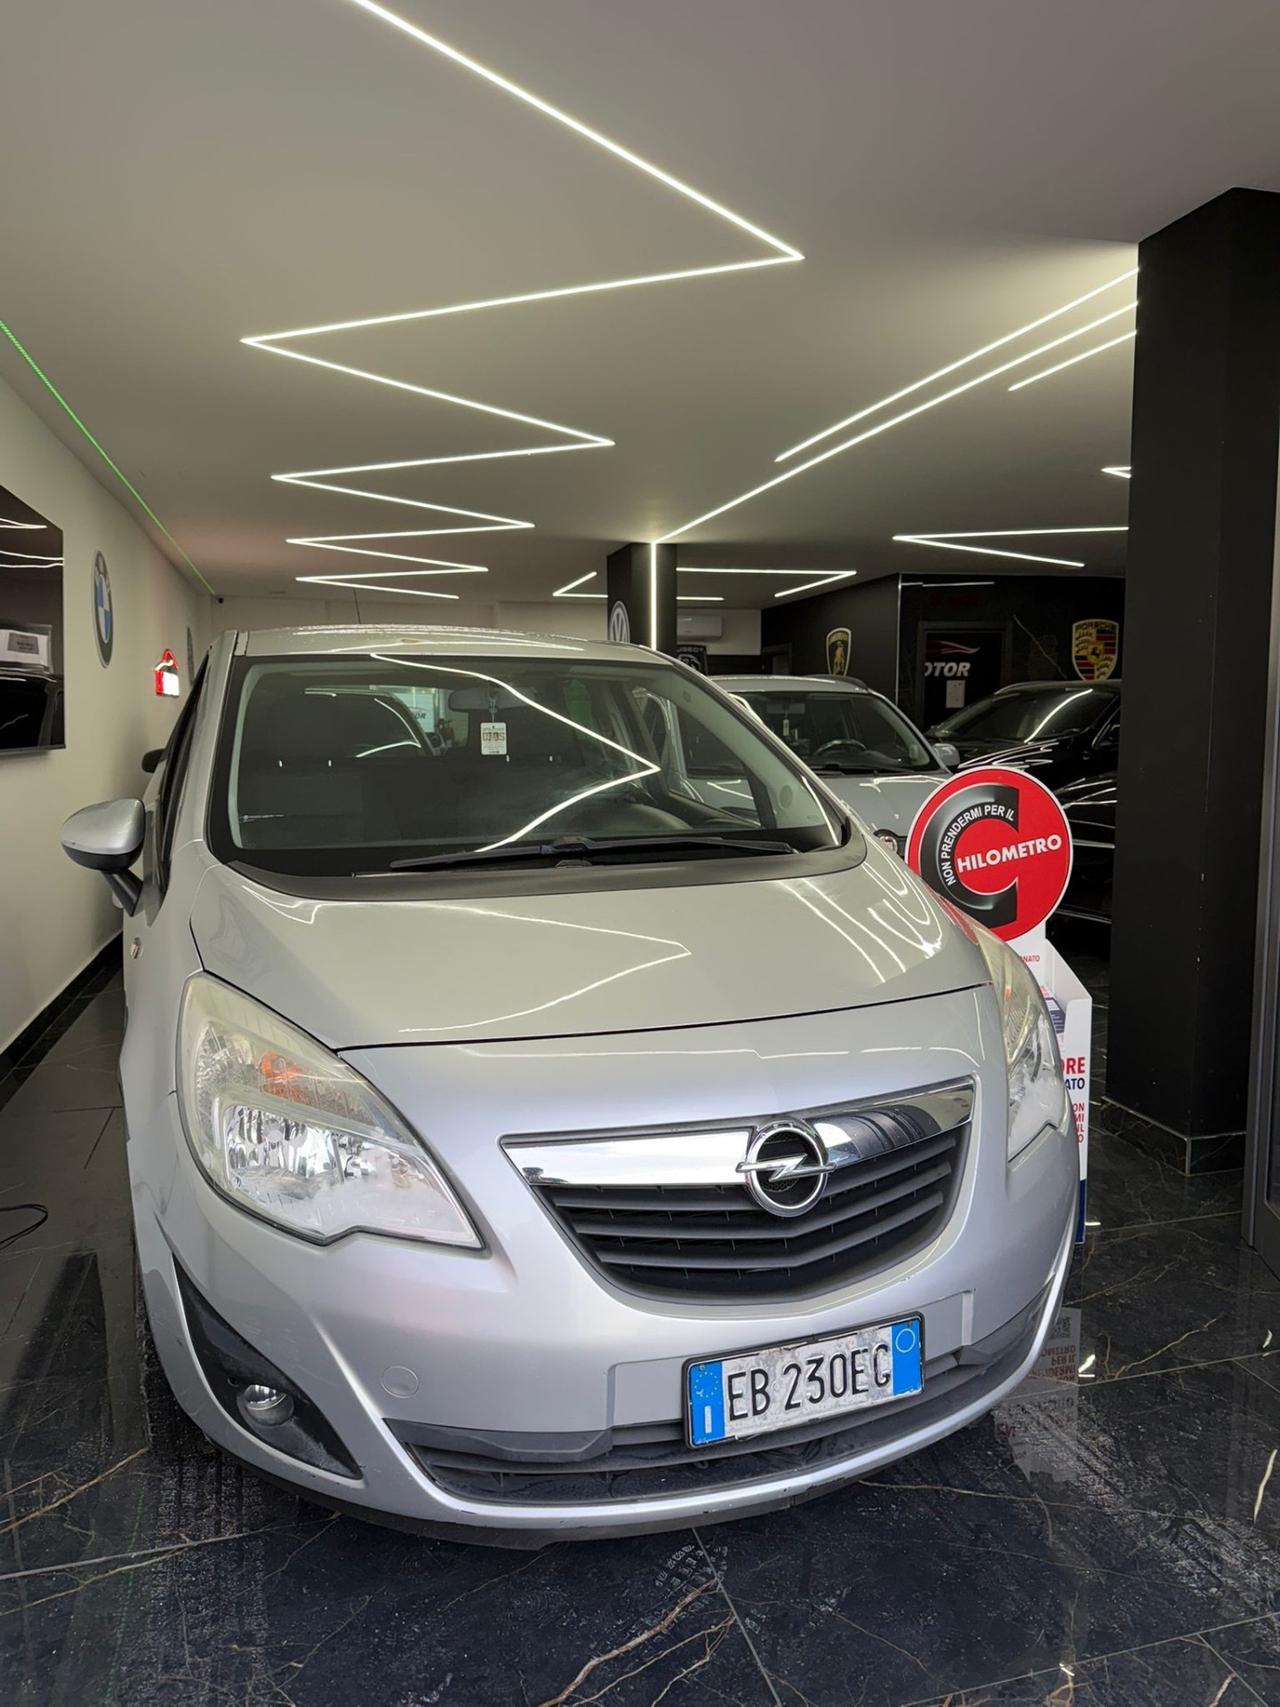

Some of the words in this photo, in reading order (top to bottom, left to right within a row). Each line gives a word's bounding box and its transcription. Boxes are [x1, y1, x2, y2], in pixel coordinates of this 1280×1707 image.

[984, 804, 1004, 816] PER
[1006, 808, 1015, 821] IL
[941, 805, 983, 859] PRENDERMI
[941, 862, 956, 886] NON
[728, 1368, 770, 1421] EB
